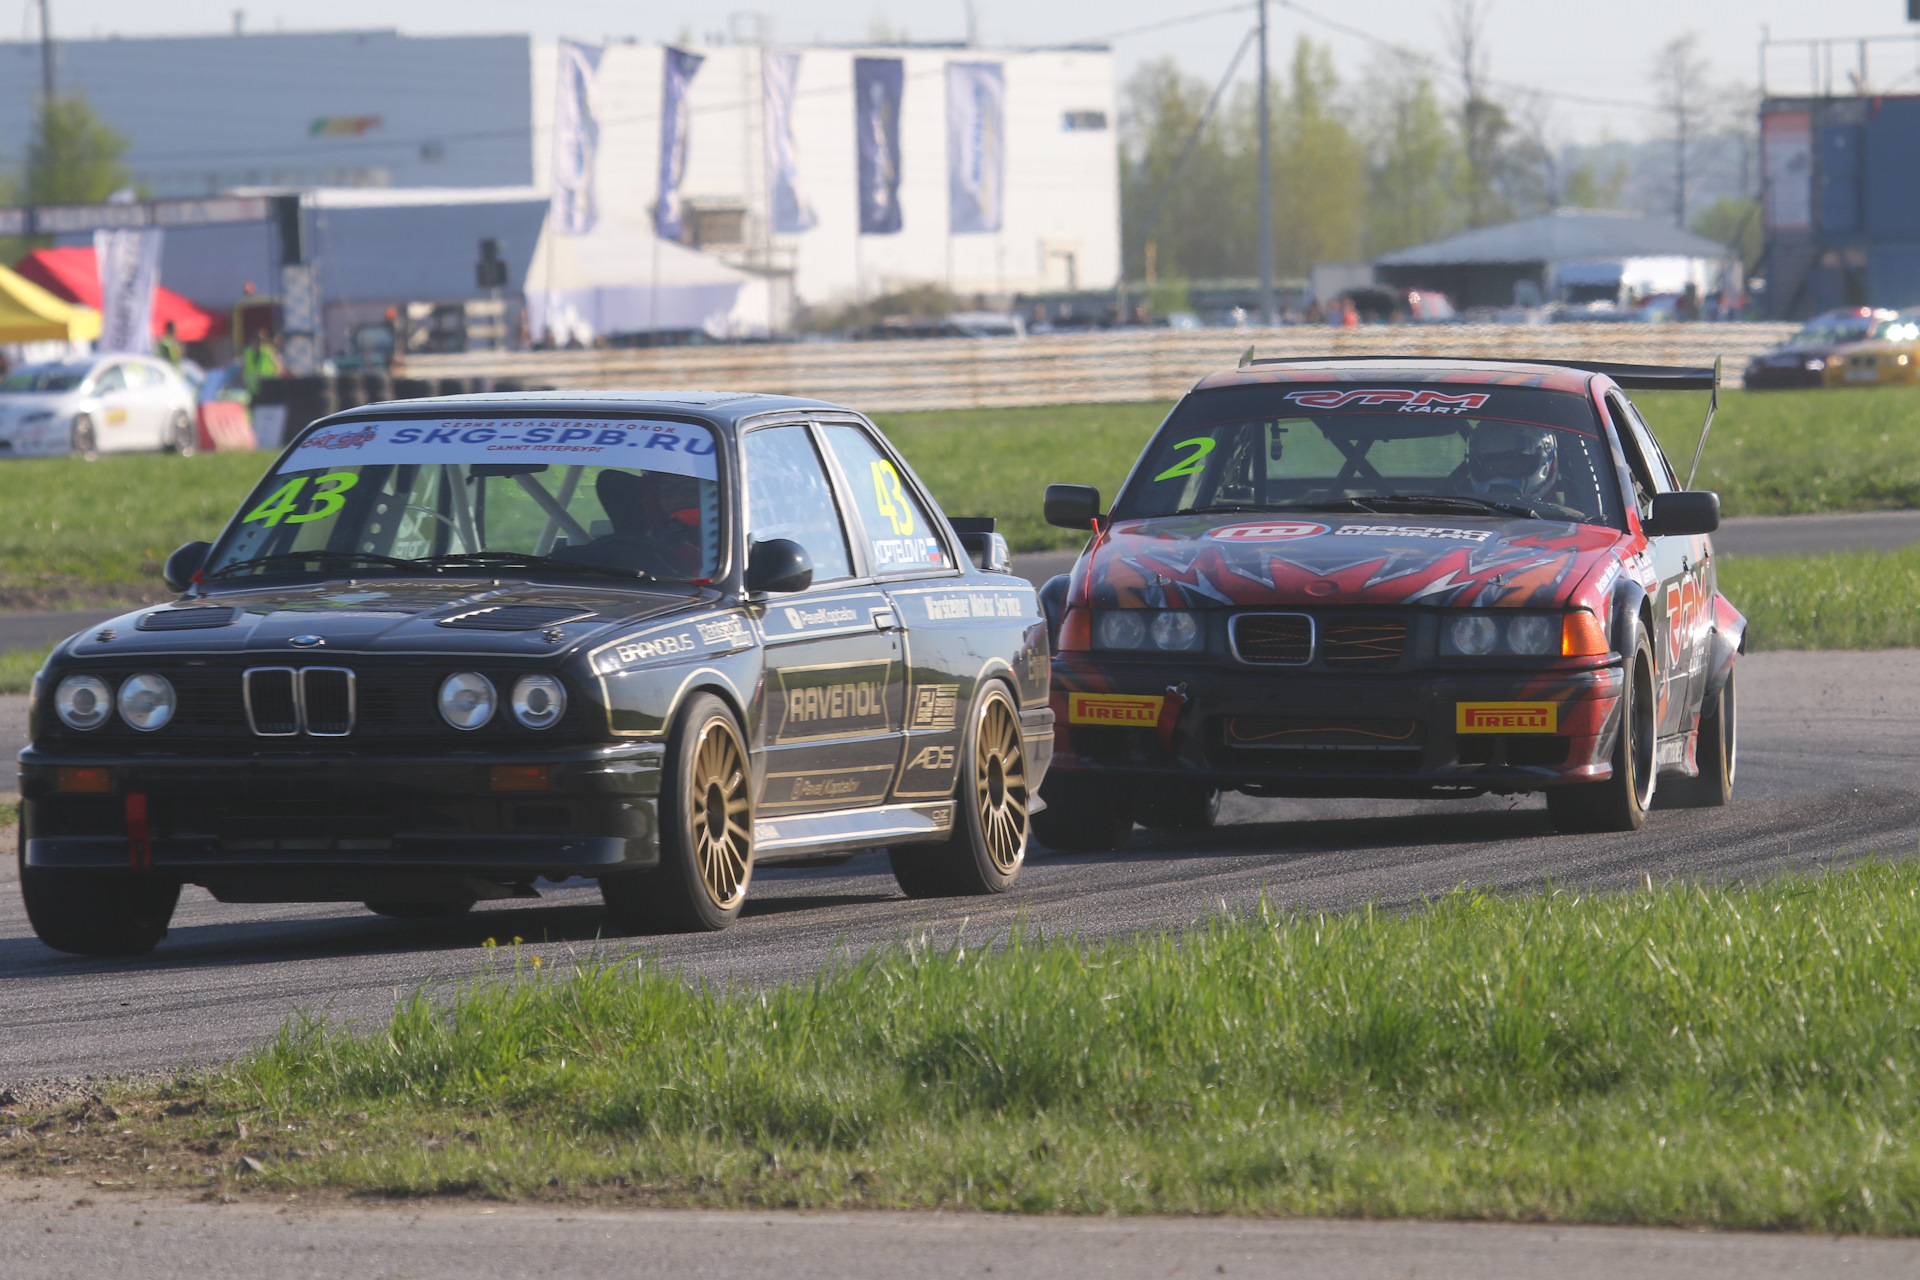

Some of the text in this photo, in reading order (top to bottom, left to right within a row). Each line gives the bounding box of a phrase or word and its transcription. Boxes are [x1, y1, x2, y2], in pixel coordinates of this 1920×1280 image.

[1397, 405, 1468, 415] KART
[441, 421, 677, 434] СЕРИЯ КОЛЬЦЕВЫХ ГОНОК
[388, 427, 716, 456] SKG-SPB.RU
[486, 444, 605, 454] САНКТ ПЕТЕРБУРГ
[1153, 436, 1216, 482] 2
[242, 472, 359, 528] 43
[870, 459, 914, 536] 43
[790, 682, 881, 722] RAVENOL
[1077, 699, 1156, 721] PIRELLI
[1465, 708, 1548, 727] PIRELLI
